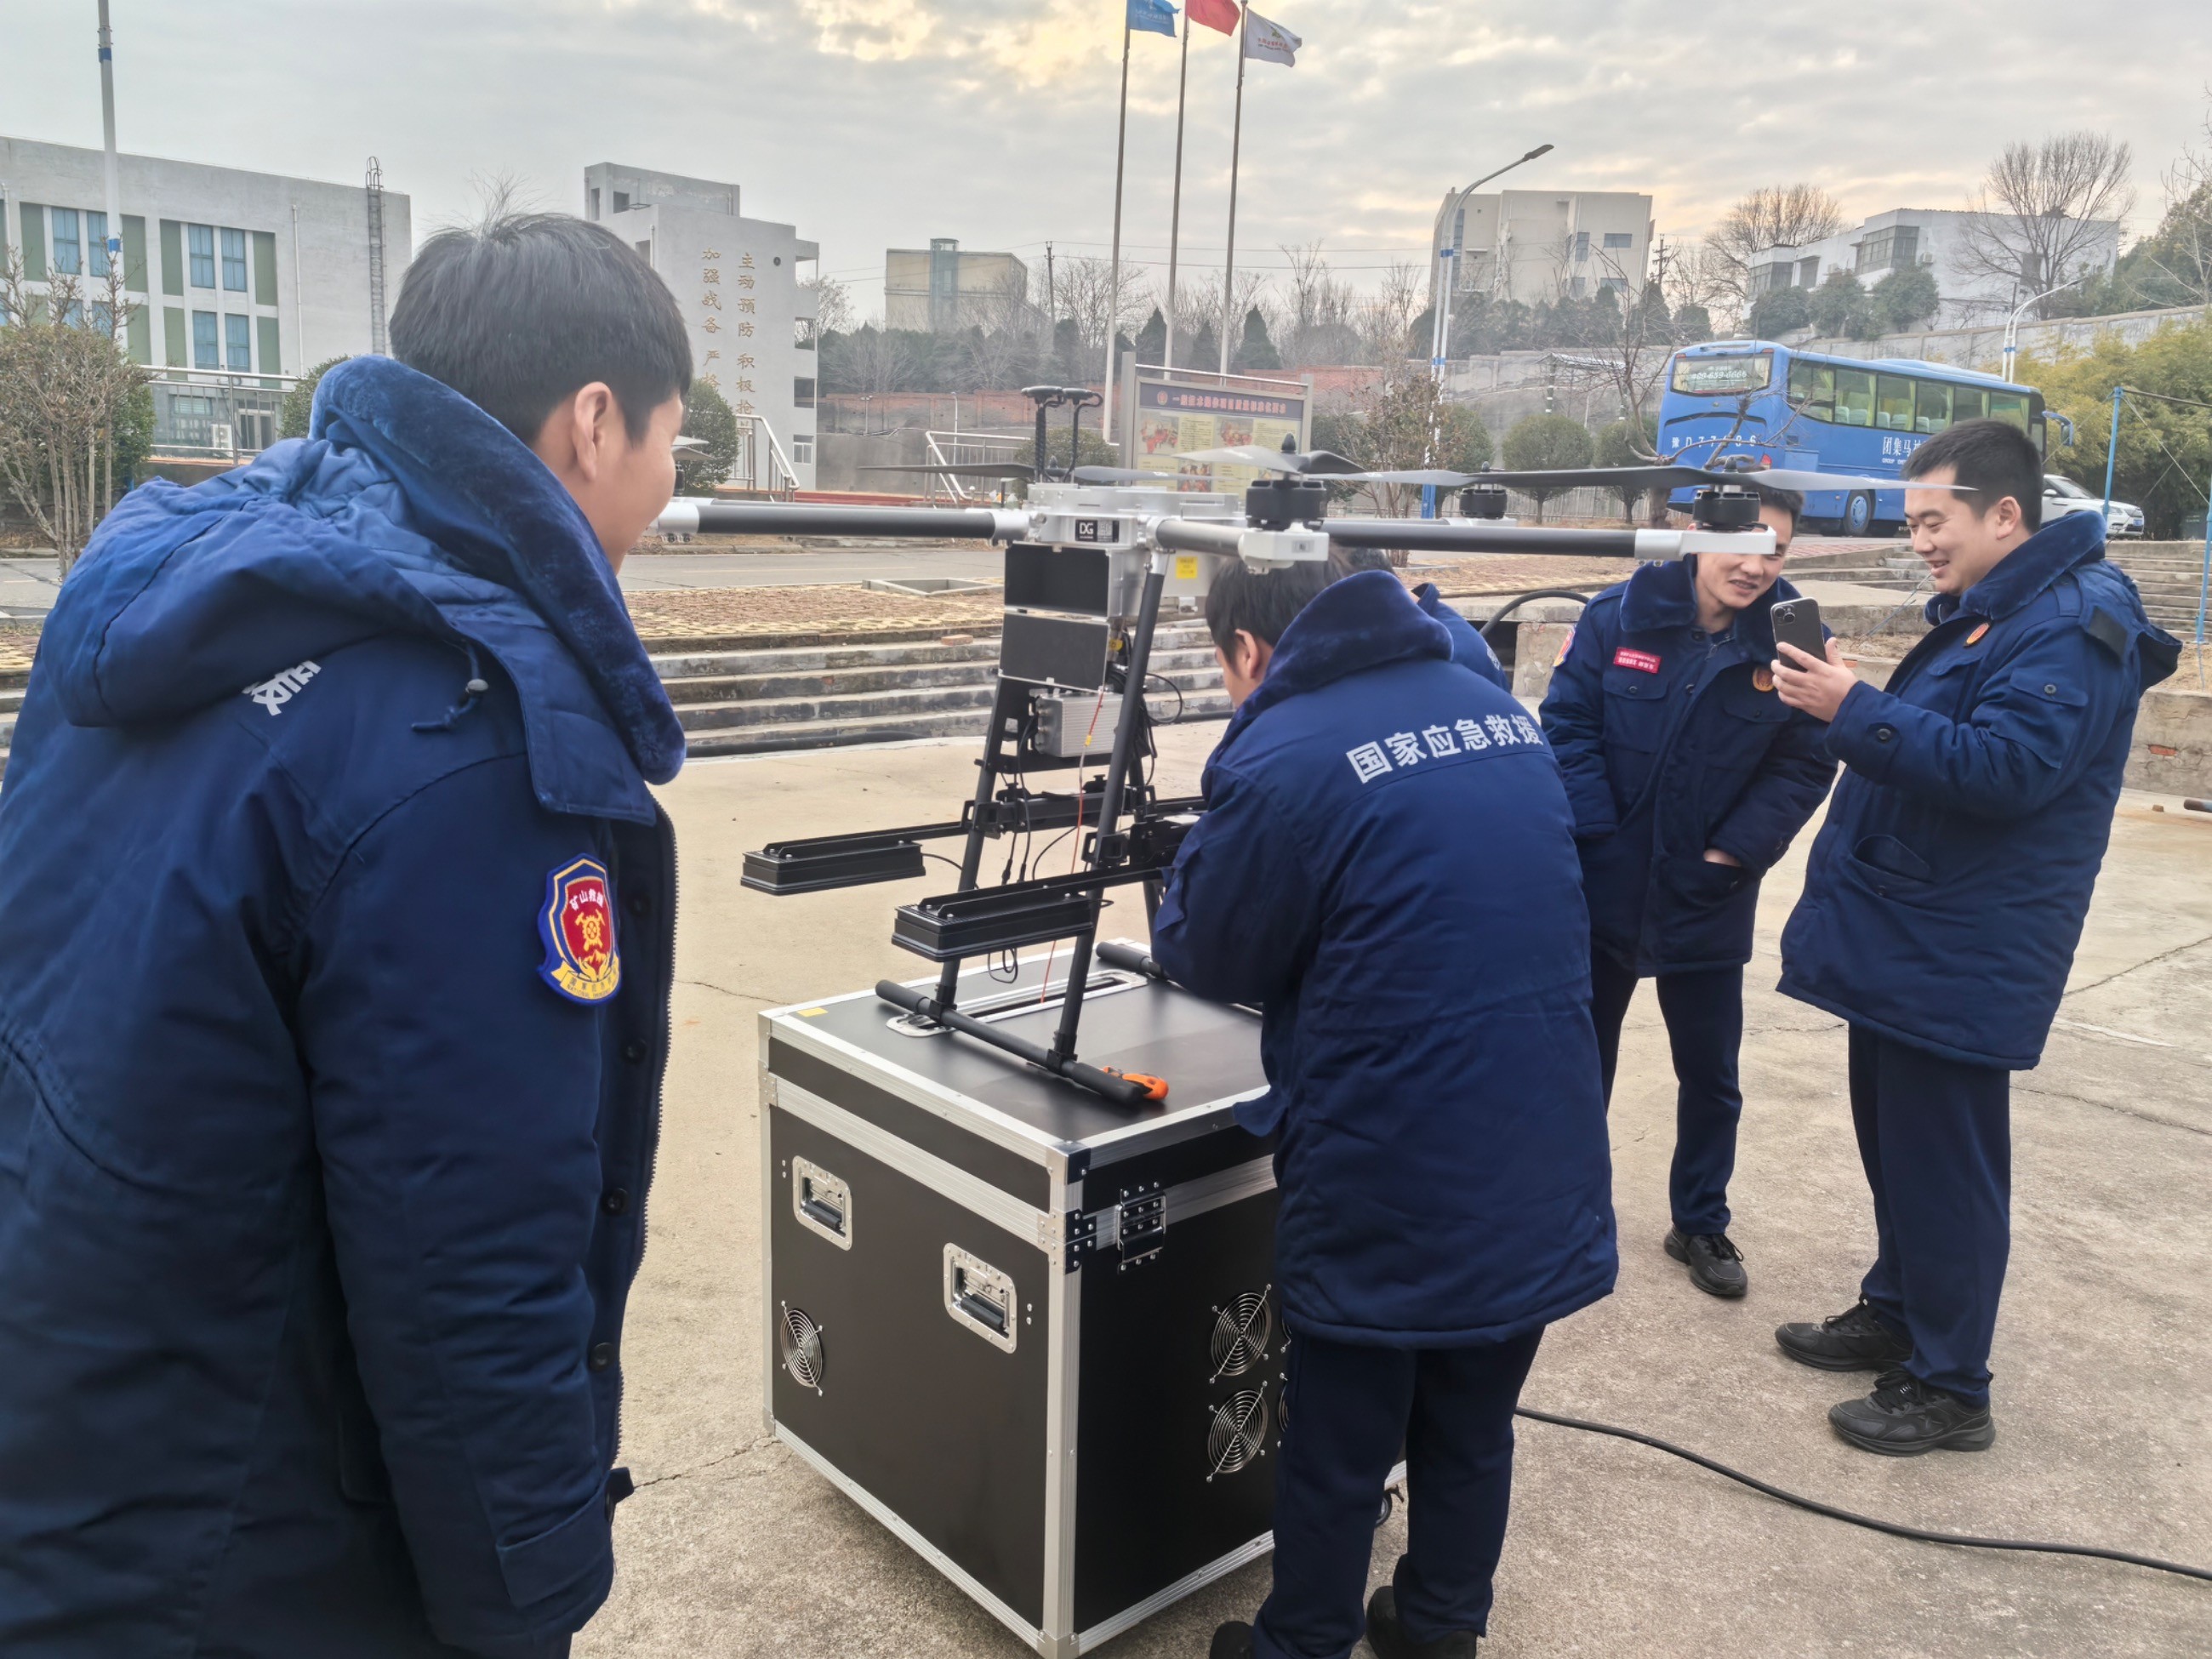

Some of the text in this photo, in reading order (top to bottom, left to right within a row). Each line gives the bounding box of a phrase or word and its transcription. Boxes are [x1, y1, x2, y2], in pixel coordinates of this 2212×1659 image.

[1080, 522, 1094, 534] DG
[1346, 713, 1544, 784] 国家应急救援
